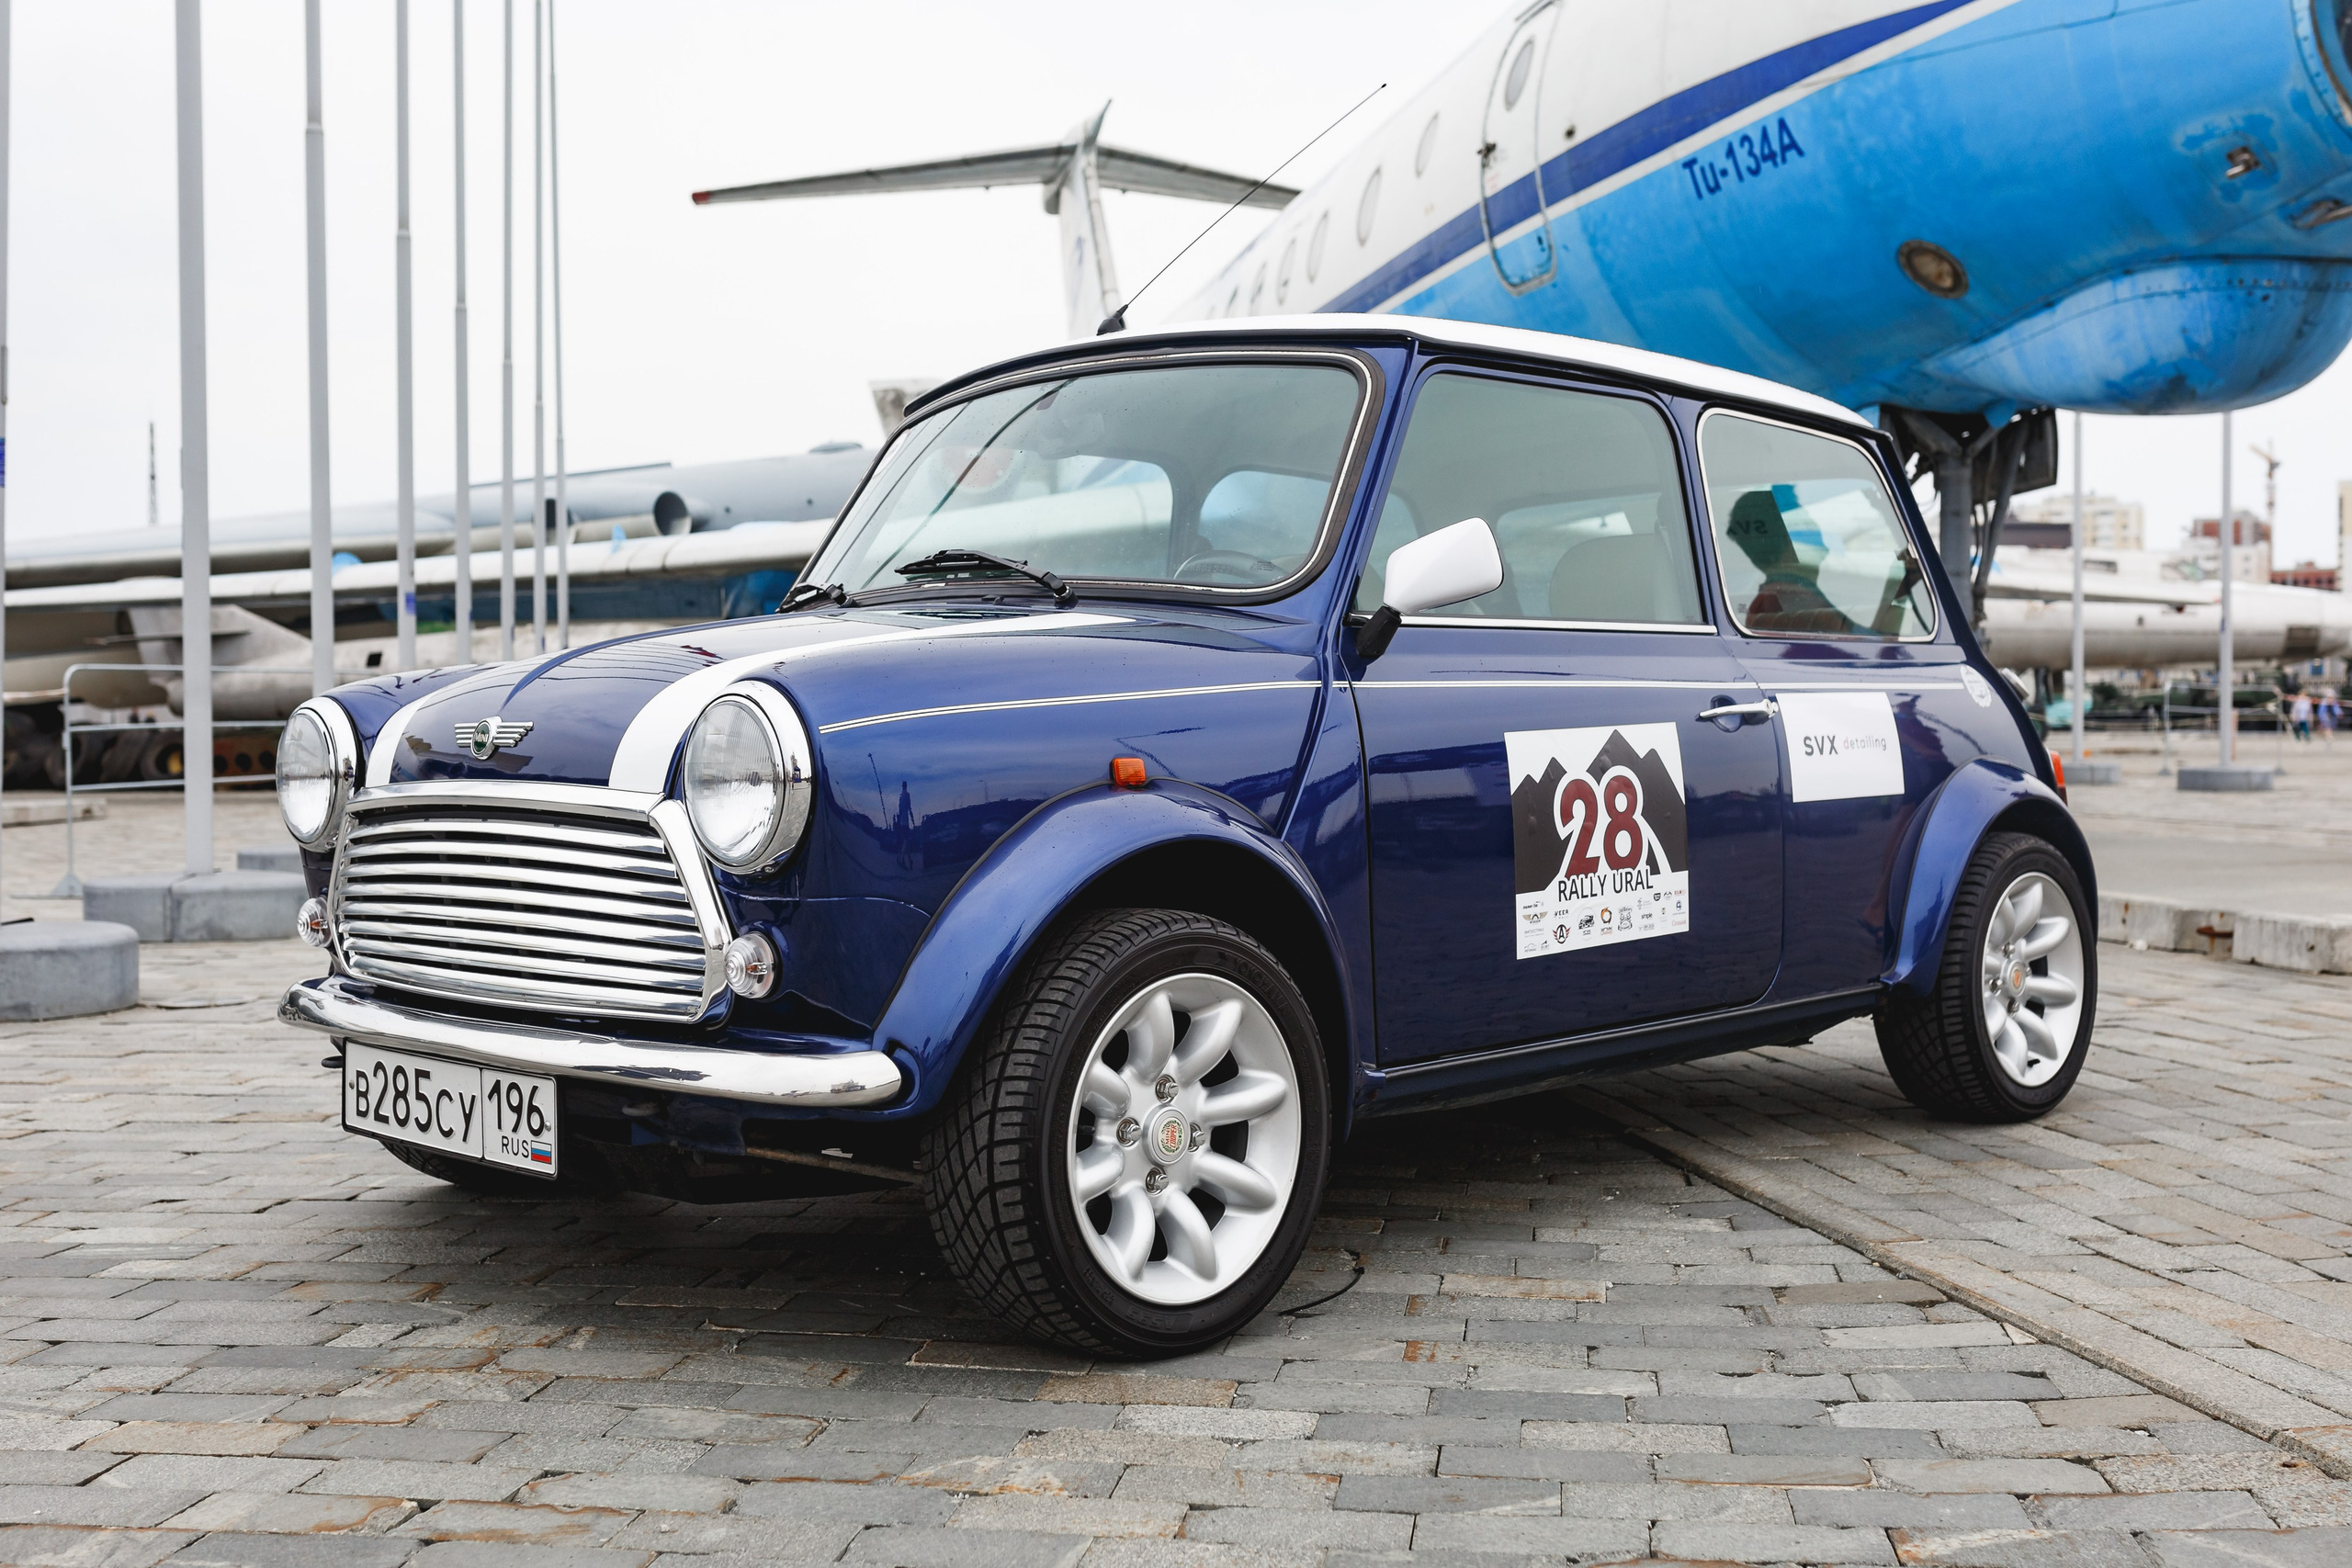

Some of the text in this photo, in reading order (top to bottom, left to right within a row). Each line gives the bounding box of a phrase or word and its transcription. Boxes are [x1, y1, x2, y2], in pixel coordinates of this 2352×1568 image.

[1682, 118, 1805, 199] Tu-134A
[474, 732, 489, 742] MINI
[1803, 735, 1887, 756] SVX detailing
[1560, 774, 1644, 879] 28
[1558, 868, 1654, 902] RALLY URAL
[488, 1079, 545, 1137] 196
[501, 1135, 529, 1158] RUS
